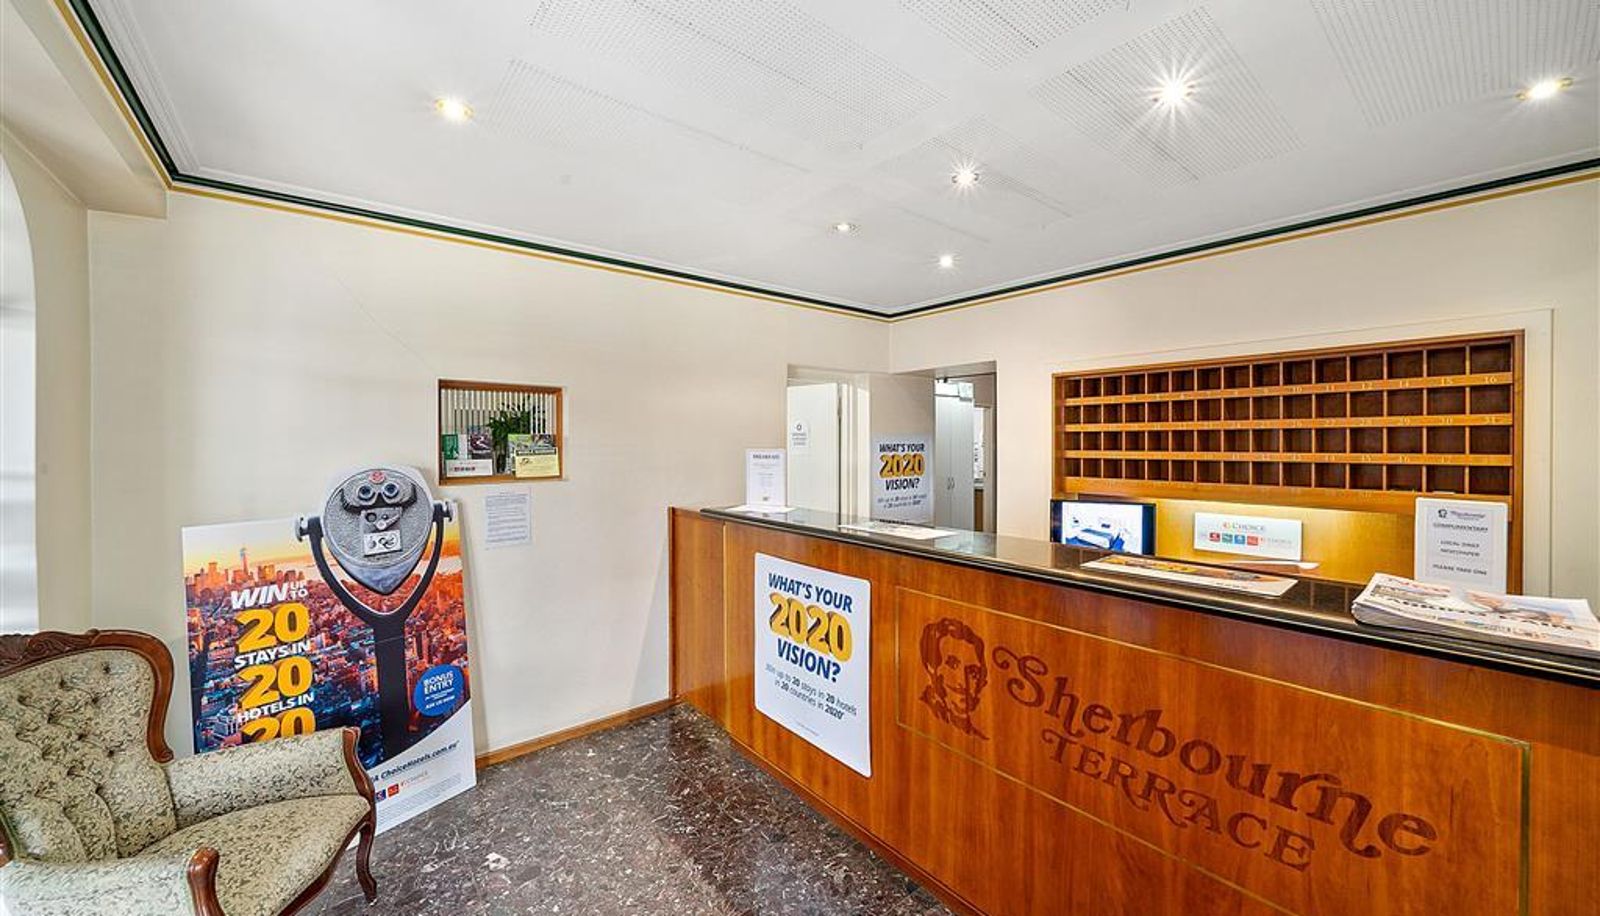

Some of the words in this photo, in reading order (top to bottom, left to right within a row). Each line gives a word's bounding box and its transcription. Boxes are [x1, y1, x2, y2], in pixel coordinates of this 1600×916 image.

[879, 443, 905, 453] WHAT'S
[907, 443, 925, 452] YOUR
[880, 453, 926, 478] 2020
[885, 478, 920, 491] VISION?
[231, 582, 288, 609] WIN
[290, 588, 308, 599] TO
[291, 580, 307, 591] UP
[768, 572, 812, 599] WHAT'S
[815, 586, 853, 613] YOUR
[234, 602, 310, 653] 20
[769, 592, 853, 662] 2020
[234, 645, 289, 669] STAYS
[293, 640, 310, 654] IN
[777, 638, 841, 683] VISION?
[238, 656, 313, 711] 20
[423, 670, 454, 687] BONUS
[424, 679, 453, 695] ENTRY
[237, 697, 296, 723] HOTELS
[298, 691, 315, 706] IN
[781, 681, 789, 692] 20
[789, 687, 816, 706] countries
[792, 676, 800, 687] 20
[801, 682, 816, 696] stays
[818, 690, 825, 699] in
[826, 692, 835, 704] 20
[836, 697, 857, 716] hotels
[991, 645, 1438, 859] Sherbourne
[1041, 728, 1316, 872] TERRACE
